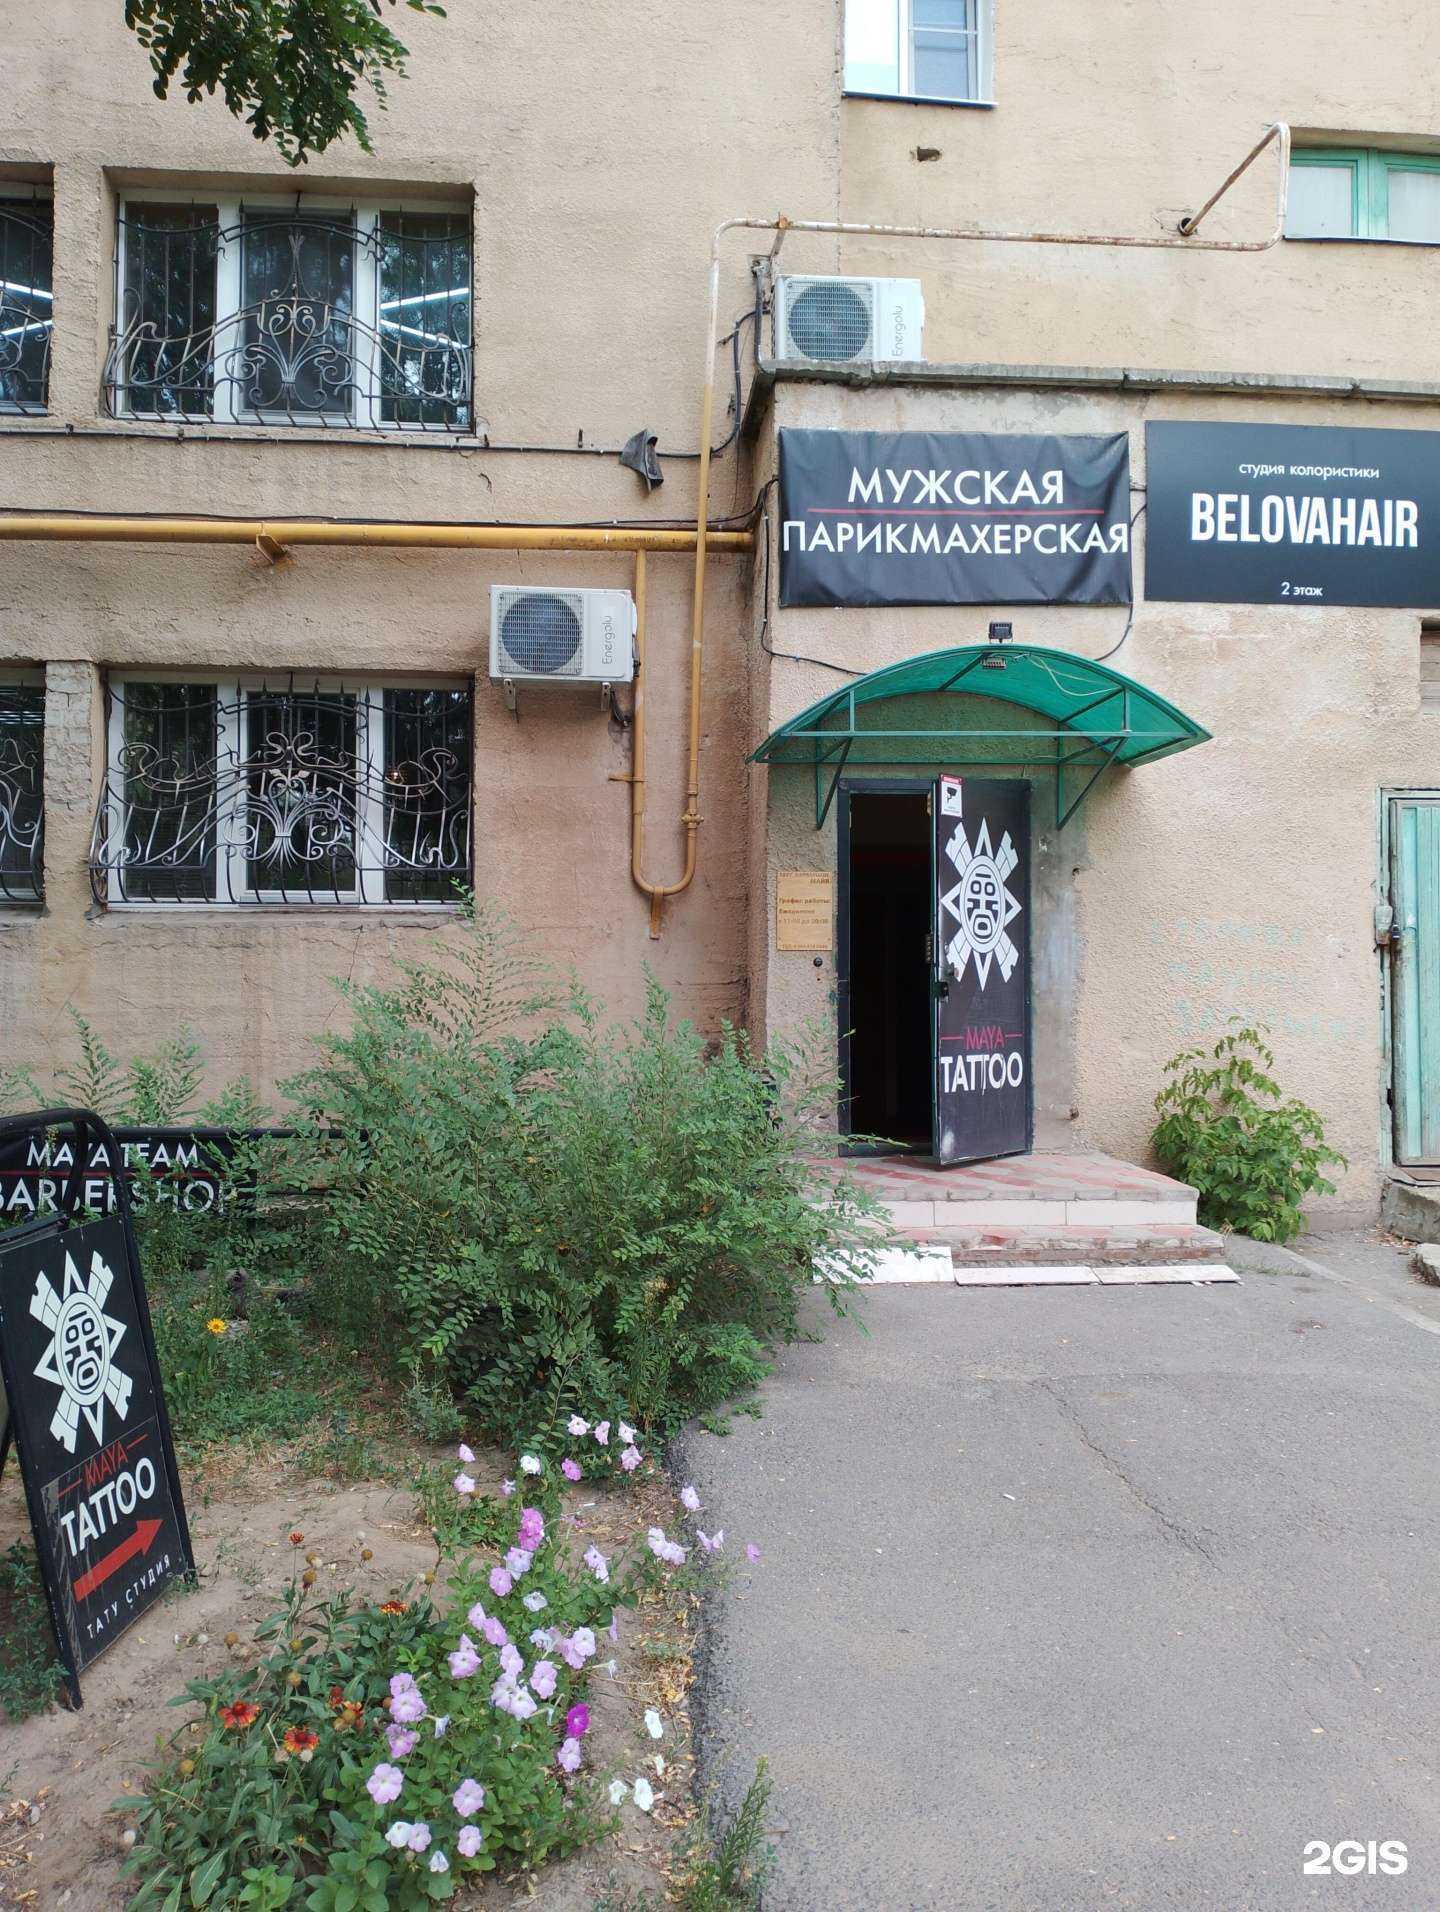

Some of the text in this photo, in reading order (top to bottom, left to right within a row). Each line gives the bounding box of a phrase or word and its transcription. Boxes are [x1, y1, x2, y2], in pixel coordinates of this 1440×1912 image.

[847, 466, 1065, 505] МУЖСКАЯ
[1238, 464, 1380, 480] студия колористики
[783, 520, 1129, 555] ПАРИКМАХЕРСКАЯ
[1191, 493, 1419, 548] BELOVAHAIR
[1280, 581, 1323, 597] 2 этаж
[964, 1025, 1005, 1052] MAYA
[940, 1051, 1023, 1095] TATTOO
[26, 1140, 111, 1168] MAA
[83, 1439, 128, 1489] MAYA
[60, 1457, 156, 1557] TATTOO
[86, 1554, 171, 1640] ТАТУ СТУДИЯ
